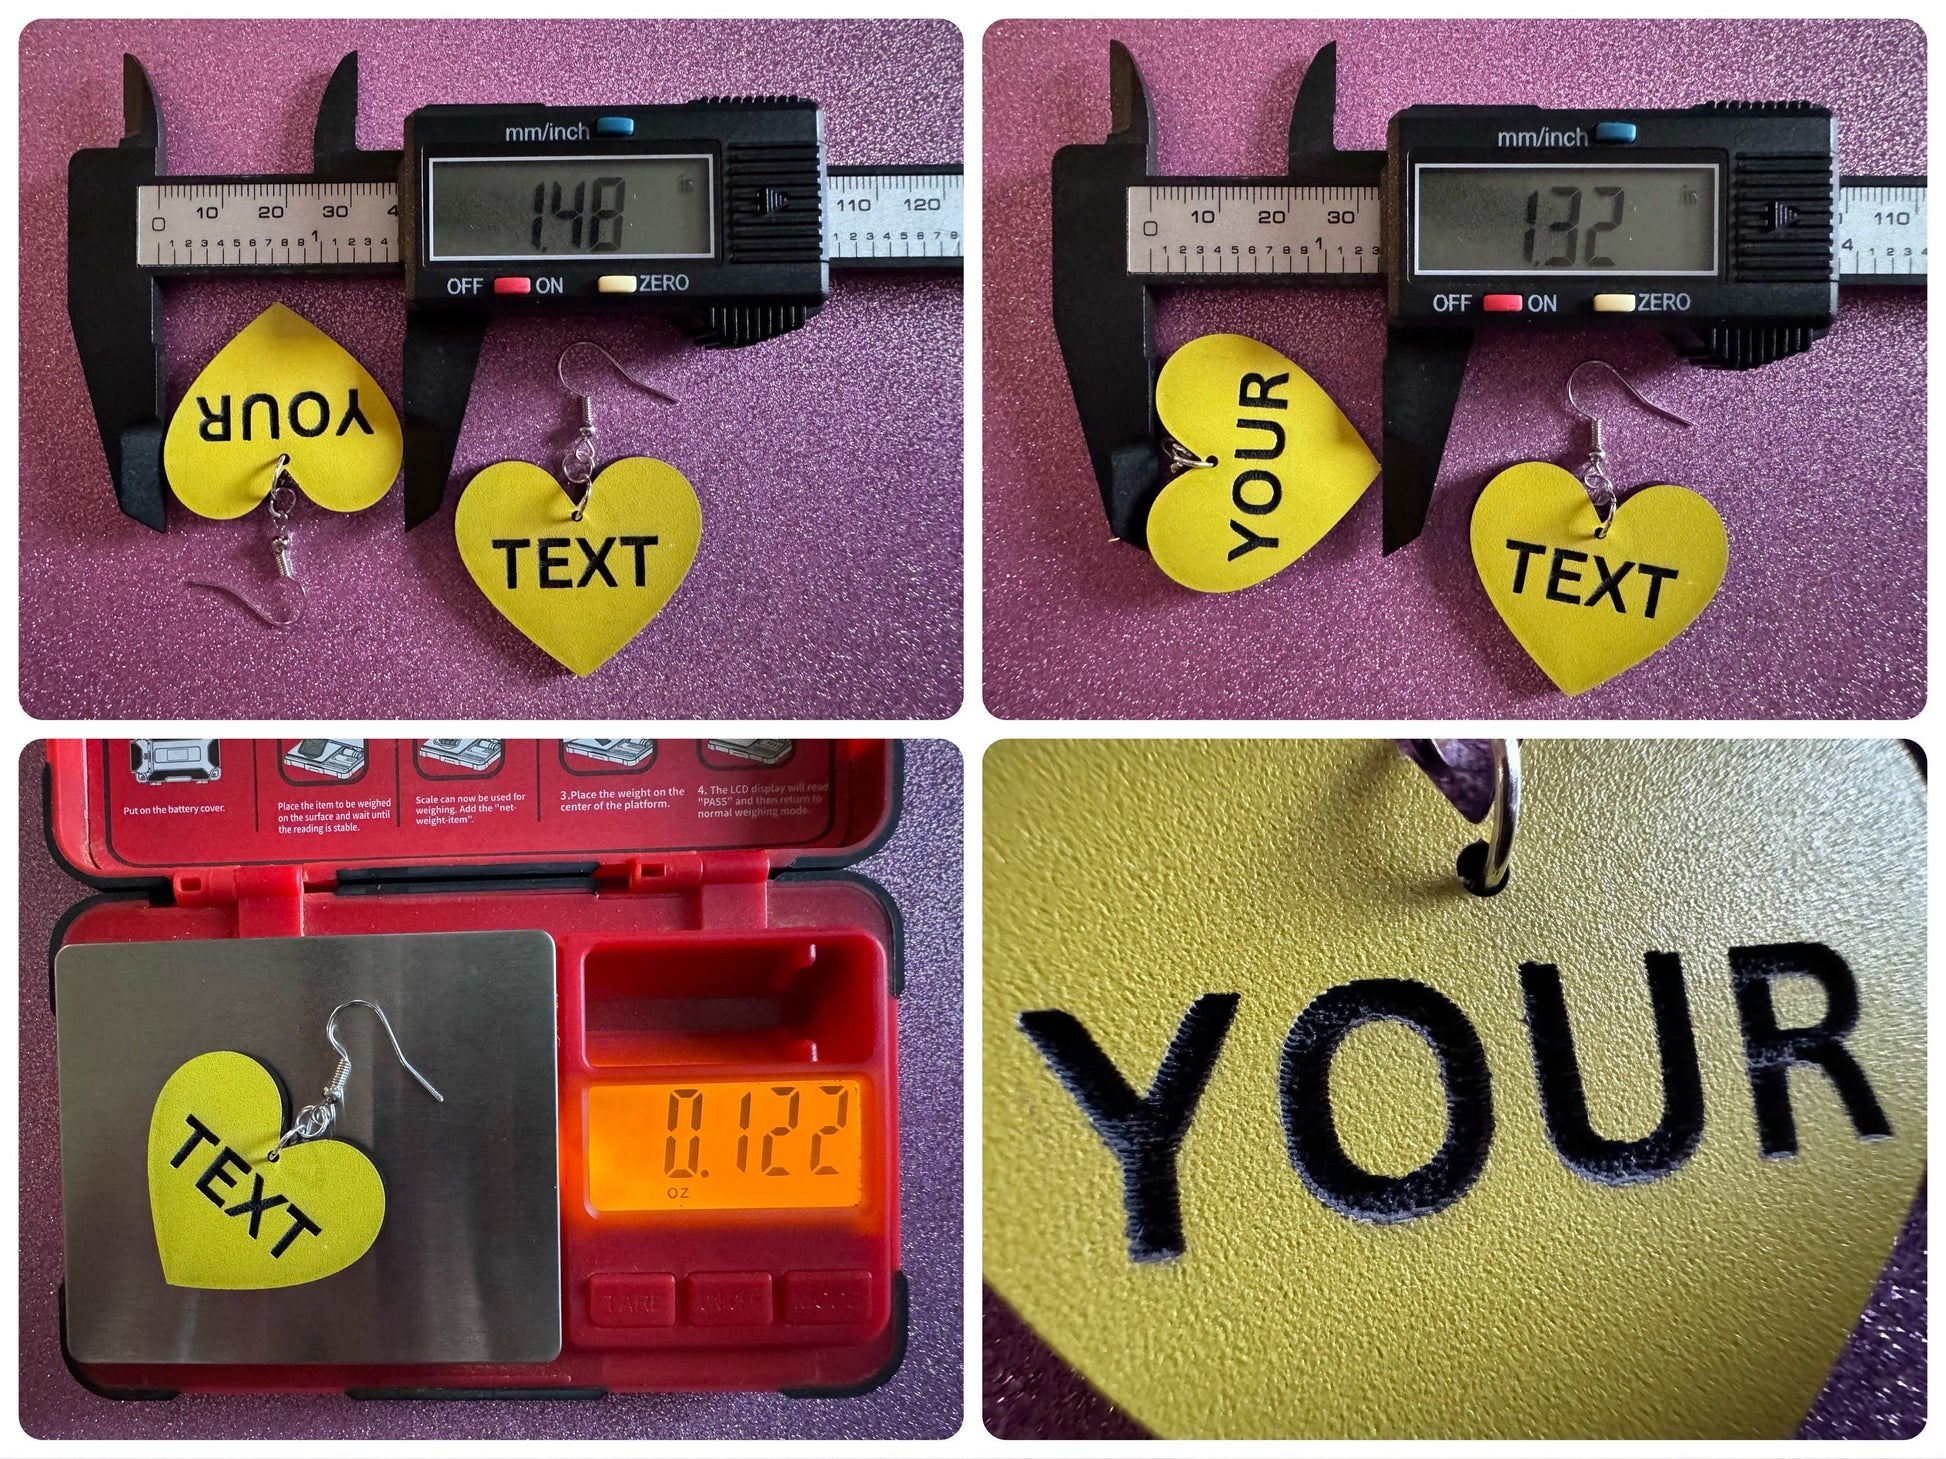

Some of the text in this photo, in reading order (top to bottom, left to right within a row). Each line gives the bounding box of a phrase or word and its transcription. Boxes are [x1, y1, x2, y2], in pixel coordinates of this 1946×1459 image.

[505, 122, 590, 142] mm/inch
[1498, 126, 1589, 147] mm/inch
[196, 204, 399, 219] 10 20 30 4
[837, 198, 942, 212] 110 120
[151, 216, 166, 232] 0
[1191, 210, 1355, 224] 10 20 30
[1874, 211, 1910, 226] 110
[833, 232, 840, 241] 1
[849, 232, 858, 241] 2
[866, 232, 875, 241] 3
[883, 231, 891, 240] 4
[900, 231, 909, 240] 5
[933, 231, 942, 240] 7
[950, 230, 959, 240] 8
[1143, 220, 1158, 237] 0
[169, 239, 175, 247] 1
[185, 239, 192, 248] 2
[200, 239, 209, 248] 3
[217, 239, 225, 248] 4
[233, 239, 241, 248] 5
[249, 239, 257, 248] 6
[265, 239, 273, 247] 7
[281, 238, 289, 247] 8
[311, 229, 319, 242] 1
[332, 238, 338, 246] 1
[348, 237, 356, 246] 2
[364, 237, 372, 246] 3
[380, 237, 388, 246] 4
[1162, 236, 1380, 255] 1 2 3 4 5 6 7 8 9 1 1 2 3
[1841, 238, 1854, 251] 4
[1869, 247, 1876, 256] 1
[1886, 247, 1895, 256] 2
[1903, 247, 1912, 256] 3
[447, 274, 690, 295] OFF ON ZERO
[1432, 292, 1691, 312] OFF ON ZERO
[196, 388, 375, 443] YOUR
[1227, 371, 1290, 562] YOUR
[491, 535, 660, 590] TEXT
[1505, 538, 1679, 619] TEXT
[560, 787, 686, 801] 3.Place the weight on the
[697, 785, 709, 796] 4.
[710, 785, 728, 795] The
[730, 785, 749, 794] LCD
[750, 783, 786, 796] display
[278, 798, 391, 811] Place the item to be weighed
[415, 792, 526, 804] Scale can now be used for
[560, 799, 671, 812] center of the platform.
[697, 796, 734, 807] "PASS"
[735, 796, 754, 806] and
[755, 795, 778, 805] then
[123, 804, 226, 815] Put on the battery cover.
[278, 809, 391, 823] on the surface and wait until
[415, 805, 458, 816] weighing.
[459, 805, 477, 813] Add
[478, 804, 493, 813] the
[697, 808, 733, 818] normal
[734, 806, 779, 818] weighing
[415, 815, 475, 826] weight-item".
[278, 822, 361, 835] the reading is stable.
[1016, 941, 1893, 1265] YOUR
[664, 1084, 849, 1179] 0.122
[169, 1113, 323, 1260] TEXT
